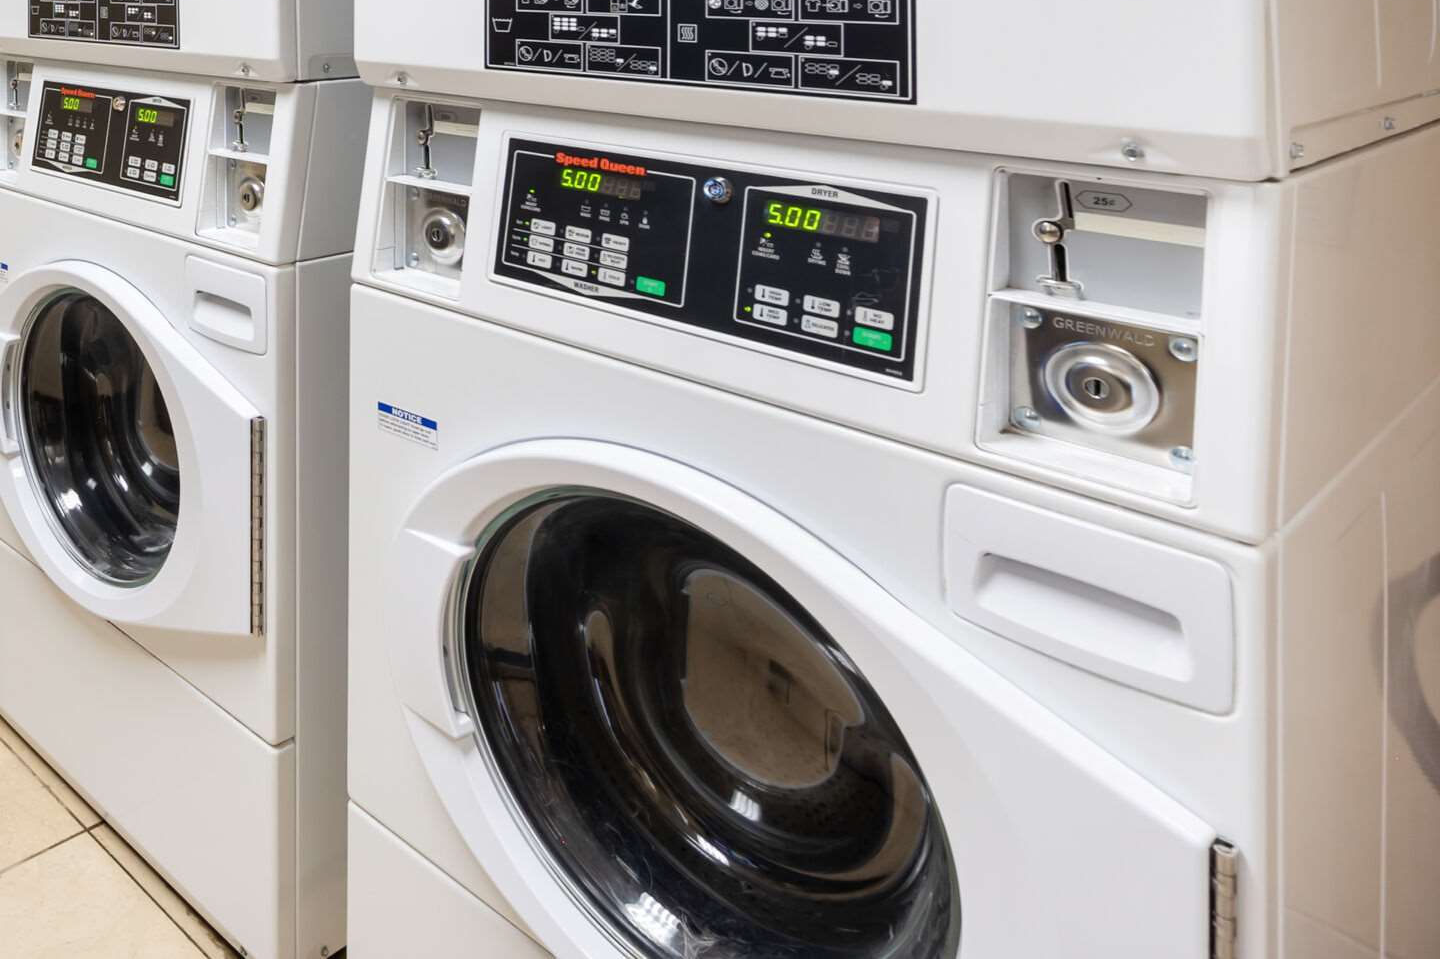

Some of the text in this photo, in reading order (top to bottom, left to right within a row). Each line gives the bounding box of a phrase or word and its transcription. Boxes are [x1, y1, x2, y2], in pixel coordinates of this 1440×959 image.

[554, 151, 647, 176] Speed Queen
[561, 169, 601, 192] 5.00
[811, 187, 839, 199] DRYER
[767, 202, 822, 231] 5.00
[1052, 316, 1155, 347] GREENWALD
[391, 407, 423, 425] NOTICE
